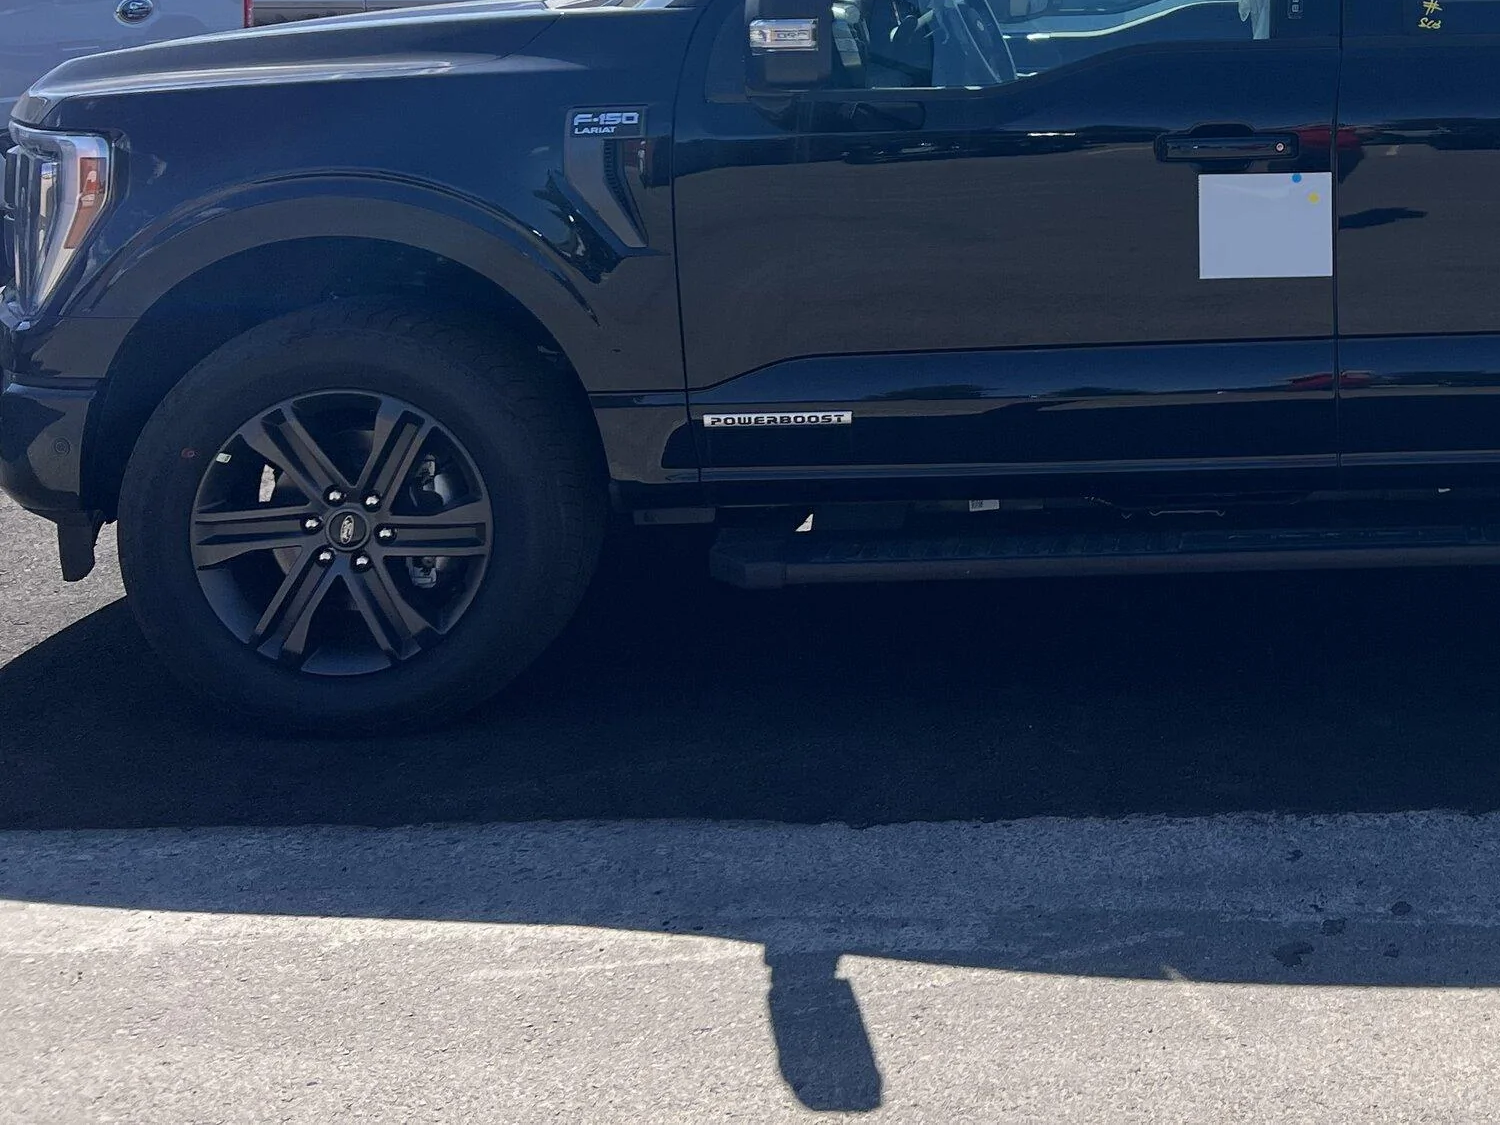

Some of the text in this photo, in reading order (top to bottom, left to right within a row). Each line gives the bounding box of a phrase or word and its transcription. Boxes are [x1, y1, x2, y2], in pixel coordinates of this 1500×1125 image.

[573, 112, 640, 126] F-150
[574, 126, 616, 134] LARIAT
[710, 414, 845, 425] POWERBOOST
